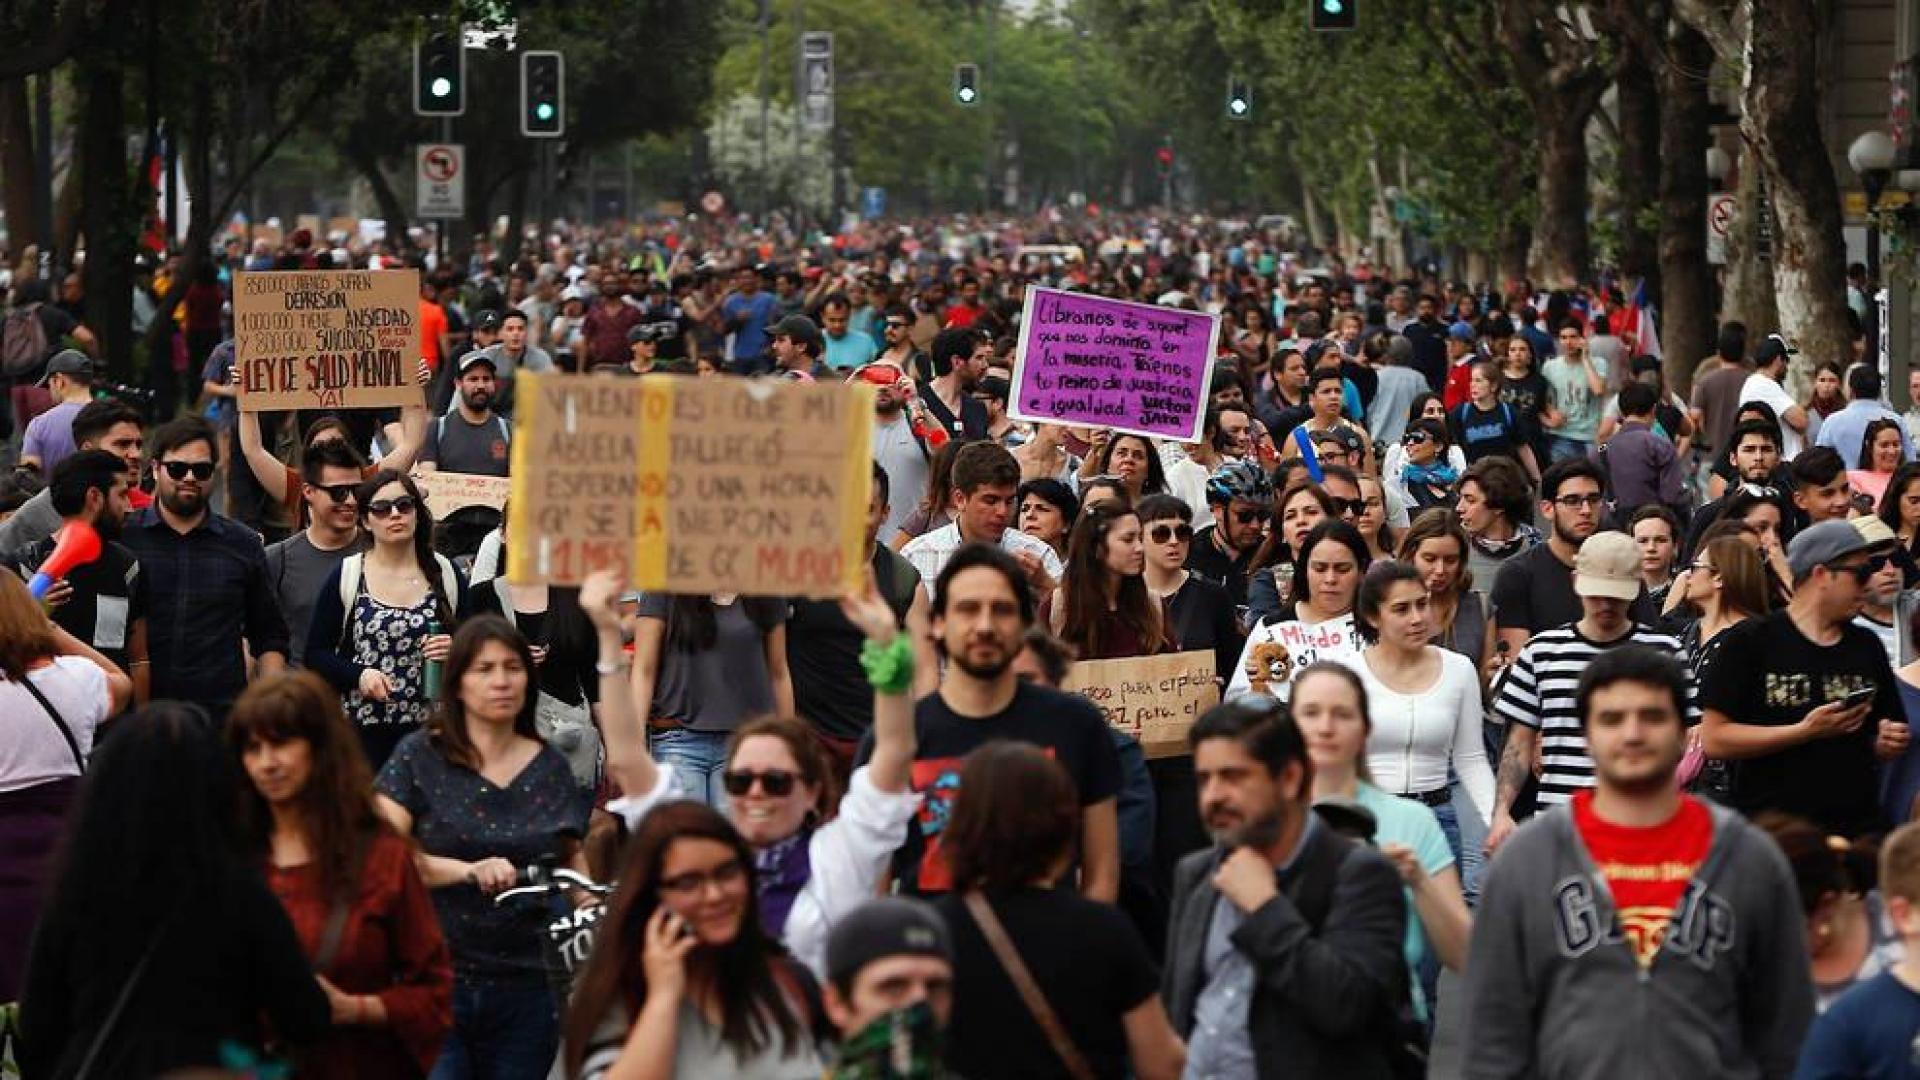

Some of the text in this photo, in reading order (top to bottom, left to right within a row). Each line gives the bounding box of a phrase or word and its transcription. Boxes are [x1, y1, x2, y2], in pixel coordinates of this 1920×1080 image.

[1065, 332, 1089, 345] nos
[1043, 347, 1058, 367] la
[243, 357, 277, 395] LEY
[304, 353, 350, 391] SALUD
[352, 348, 409, 388] MENTAL
[1058, 373, 1100, 391] reino
[312, 389, 345, 408] YA!
[801, 393, 836, 422] MI
[545, 429, 638, 466] ABUELA
[697, 475, 748, 500] UNA
[760, 472, 836, 500] HORA
[585, 503, 616, 536] SE
[806, 509, 834, 542] A
[554, 538, 575, 580] 1
